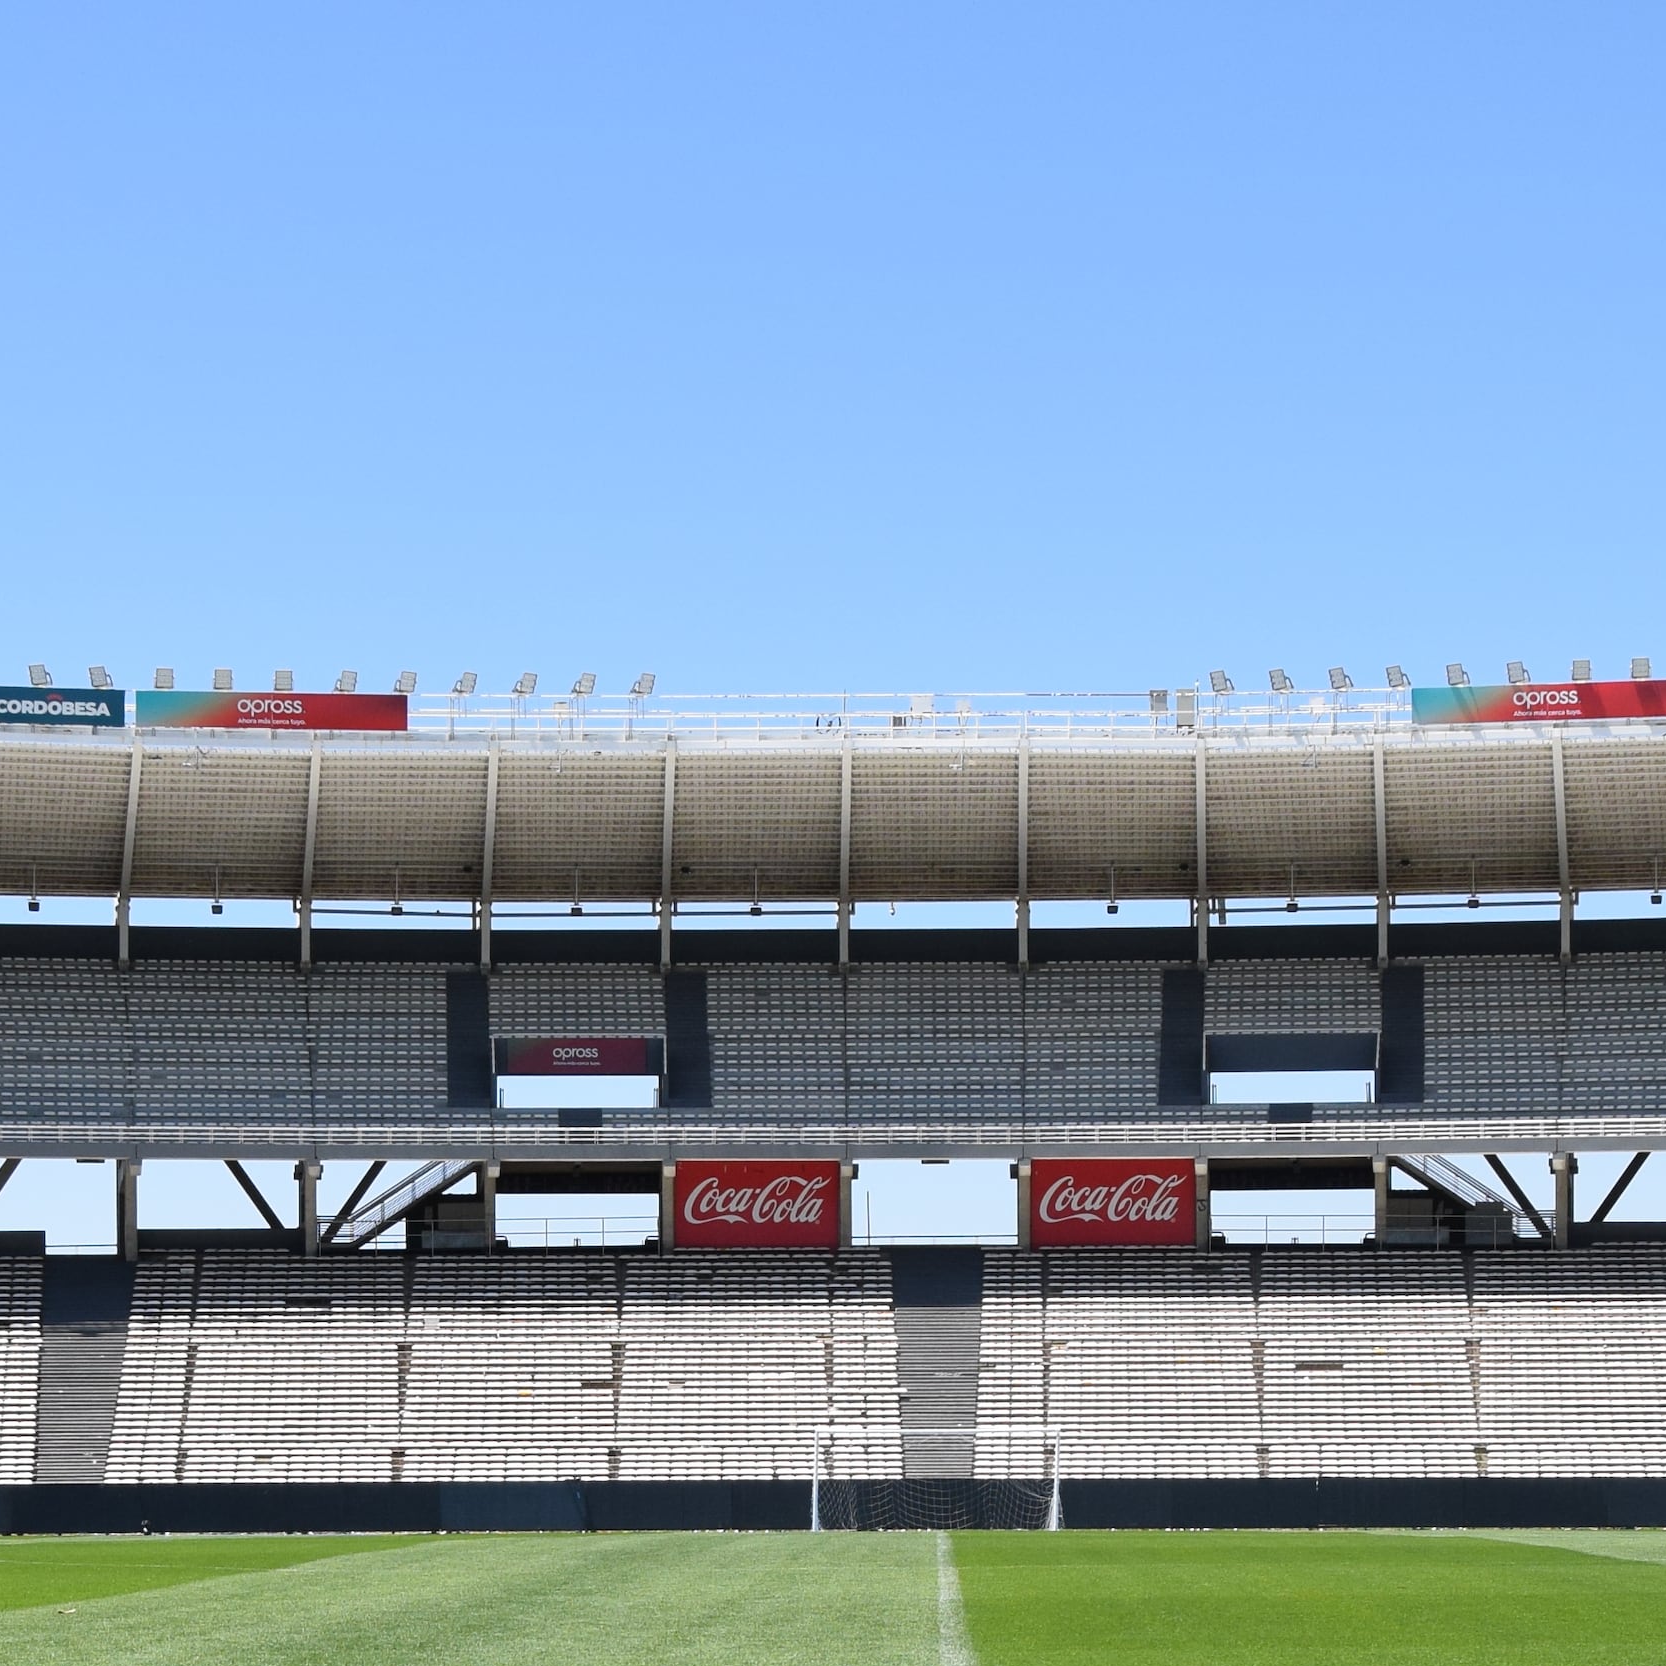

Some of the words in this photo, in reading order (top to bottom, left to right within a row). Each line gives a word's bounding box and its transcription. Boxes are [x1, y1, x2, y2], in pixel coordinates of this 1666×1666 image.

[552, 1047, 599, 1061] apross
[684, 1175, 832, 1225] Coca-Cola
[1039, 1174, 1187, 1223] Coca-Cola
